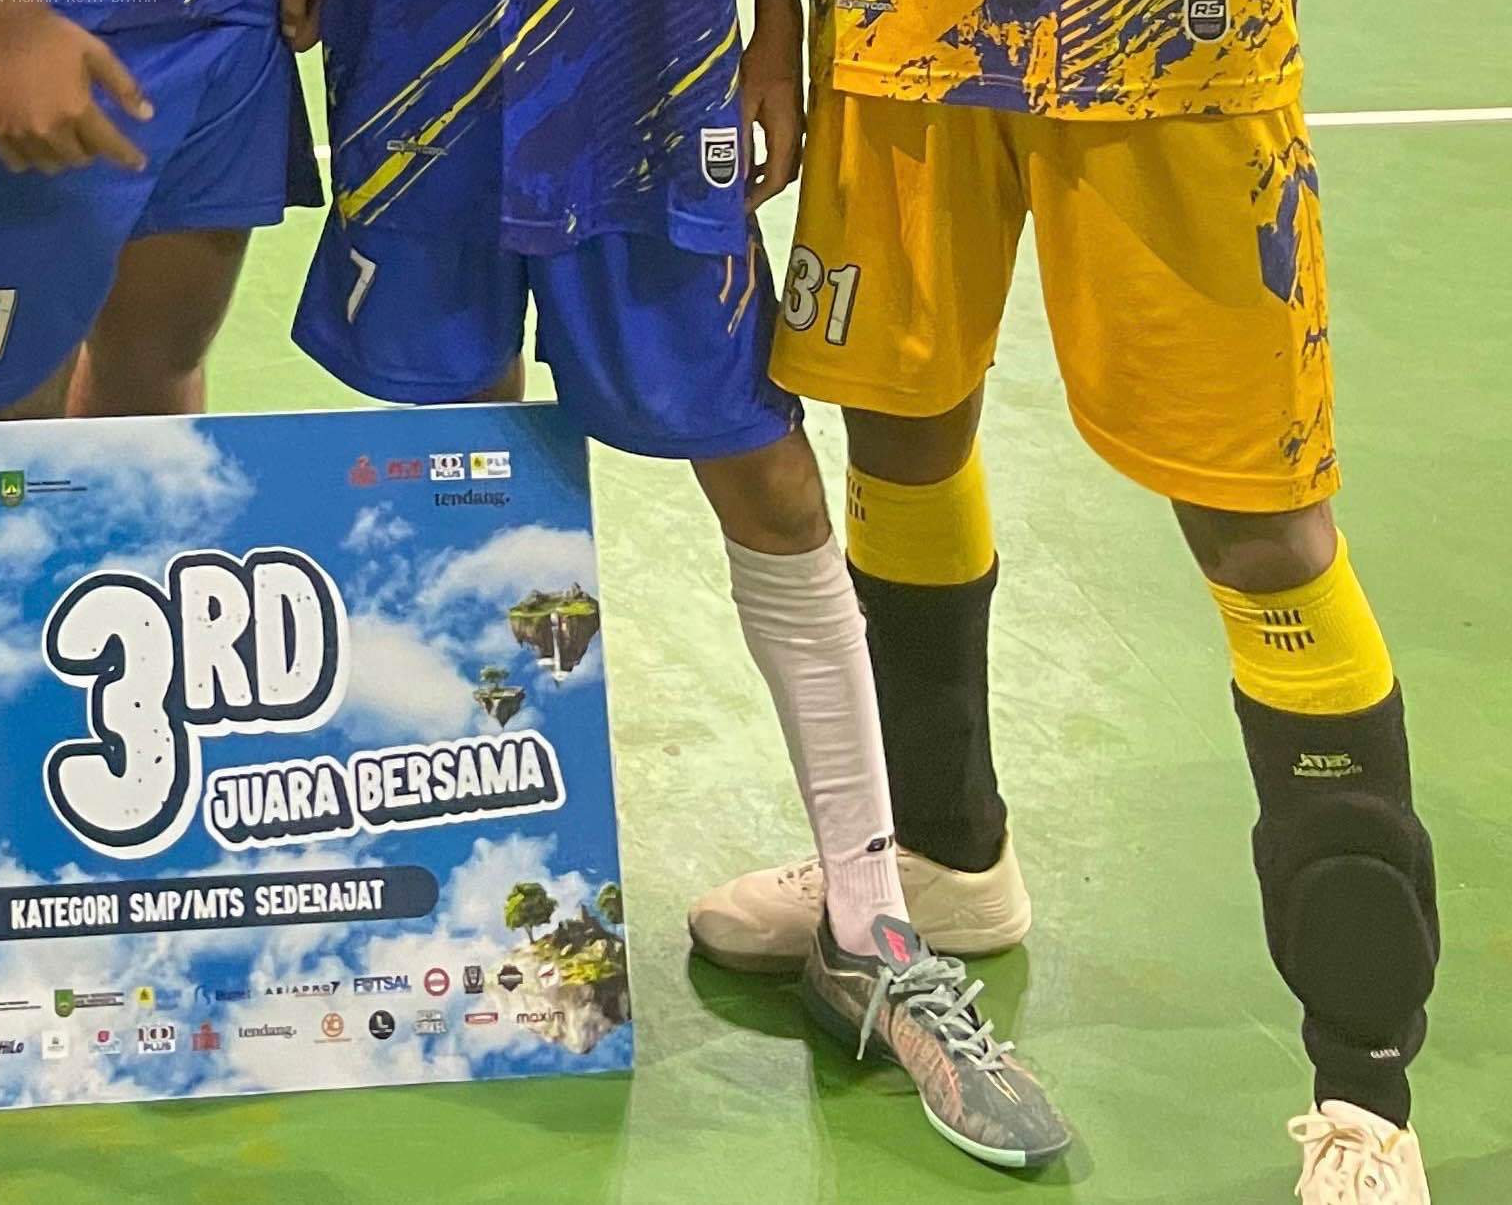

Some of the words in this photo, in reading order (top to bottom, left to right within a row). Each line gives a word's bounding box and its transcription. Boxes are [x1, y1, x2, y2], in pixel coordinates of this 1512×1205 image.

[785, 244, 861, 347] 31
[46, 548, 338, 847] 3RD
[213, 764, 344, 834] JUARA
[356, 737, 550, 814] BERSAMA
[10, 894, 120, 931] KATEGORI
[129, 886, 245, 924] SMP/MTS
[254, 878, 385, 917] SEDERAJAT
[515, 1007, 566, 1024] maxim
